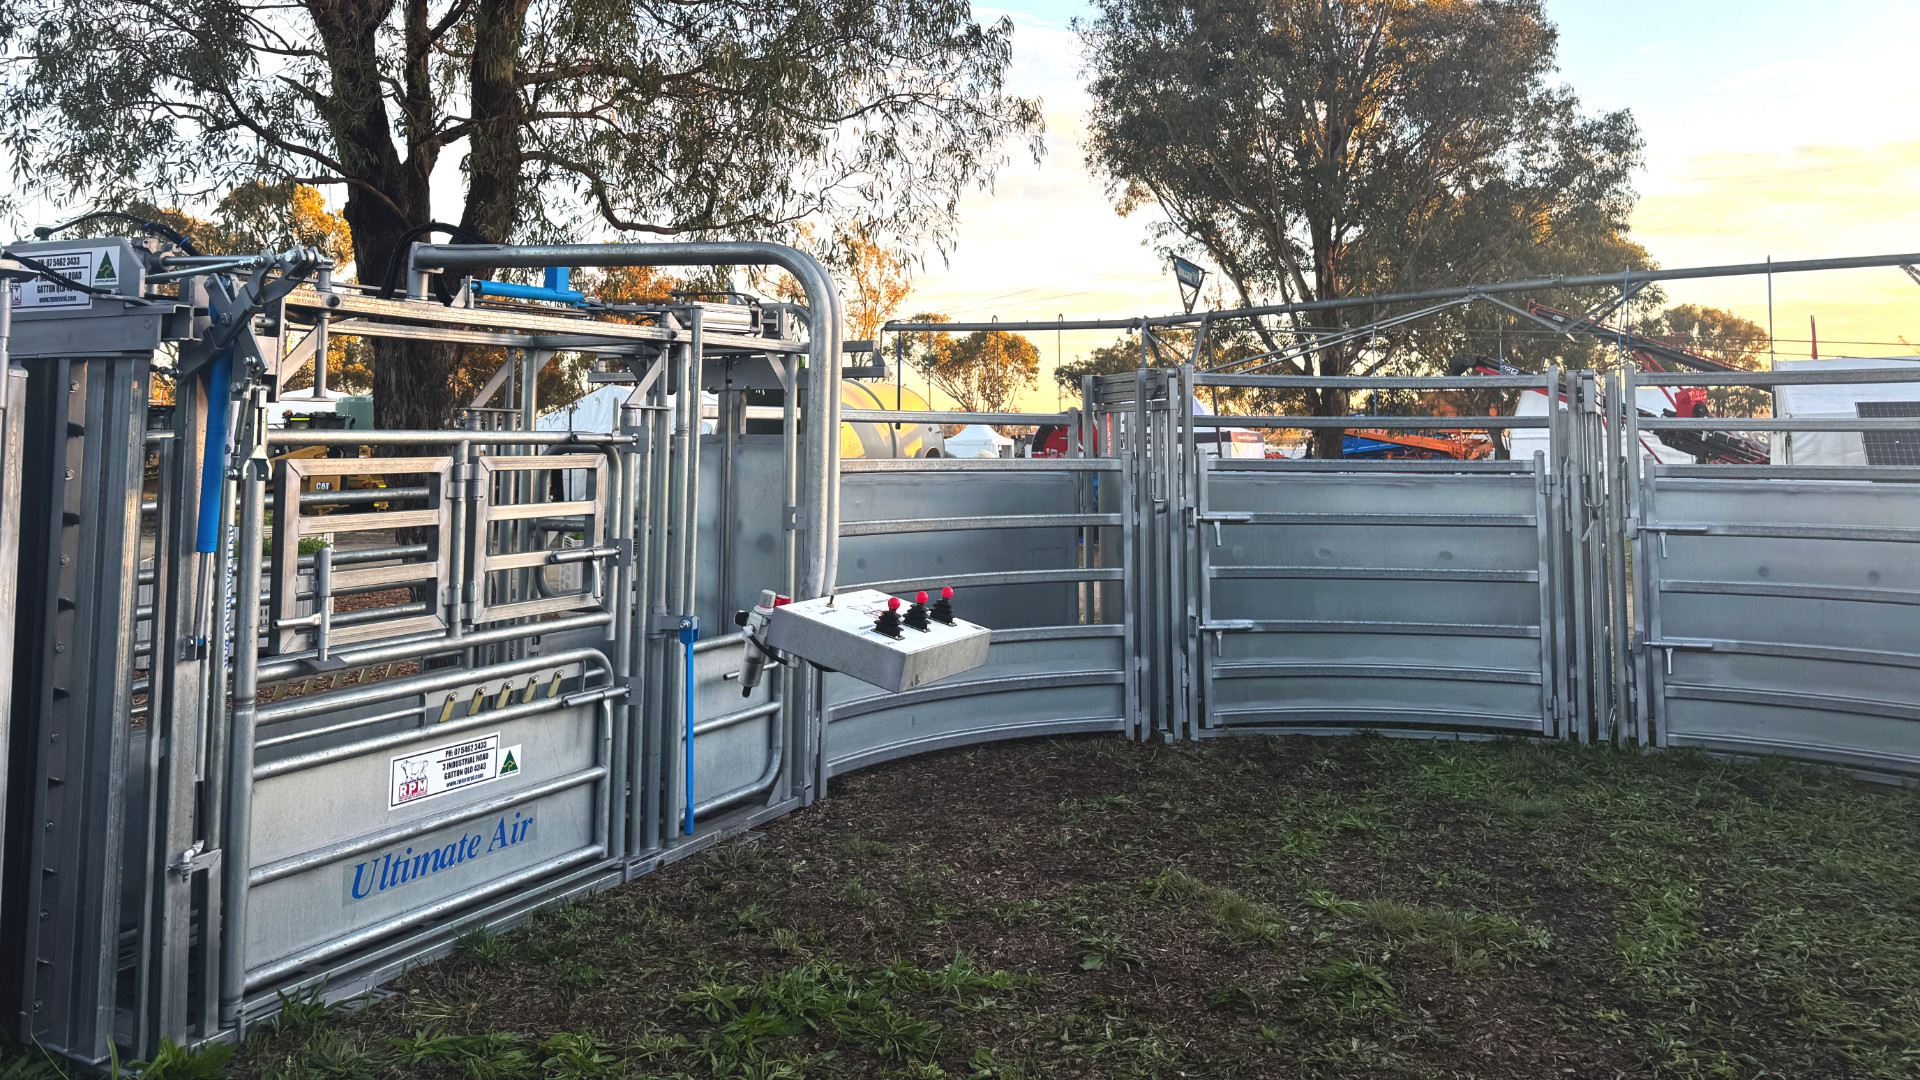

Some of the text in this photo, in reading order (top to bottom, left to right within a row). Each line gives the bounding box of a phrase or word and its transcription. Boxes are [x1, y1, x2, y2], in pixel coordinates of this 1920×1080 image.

[53, 257, 67, 267] 5462
[67, 256, 80, 266] 3433
[36, 284, 56, 294] GATTON
[316, 482, 331, 490] CAT
[445, 749, 454, 758] PH:
[454, 747, 460, 756] 07
[474, 741, 488, 751] 3433
[442, 752, 489, 771] 3 INDUSTRIAL ROAD
[443, 762, 487, 780] GATTON QLD 4343
[400, 779, 427, 797] RPM
[352, 811, 534, 900] Ultimate Air
